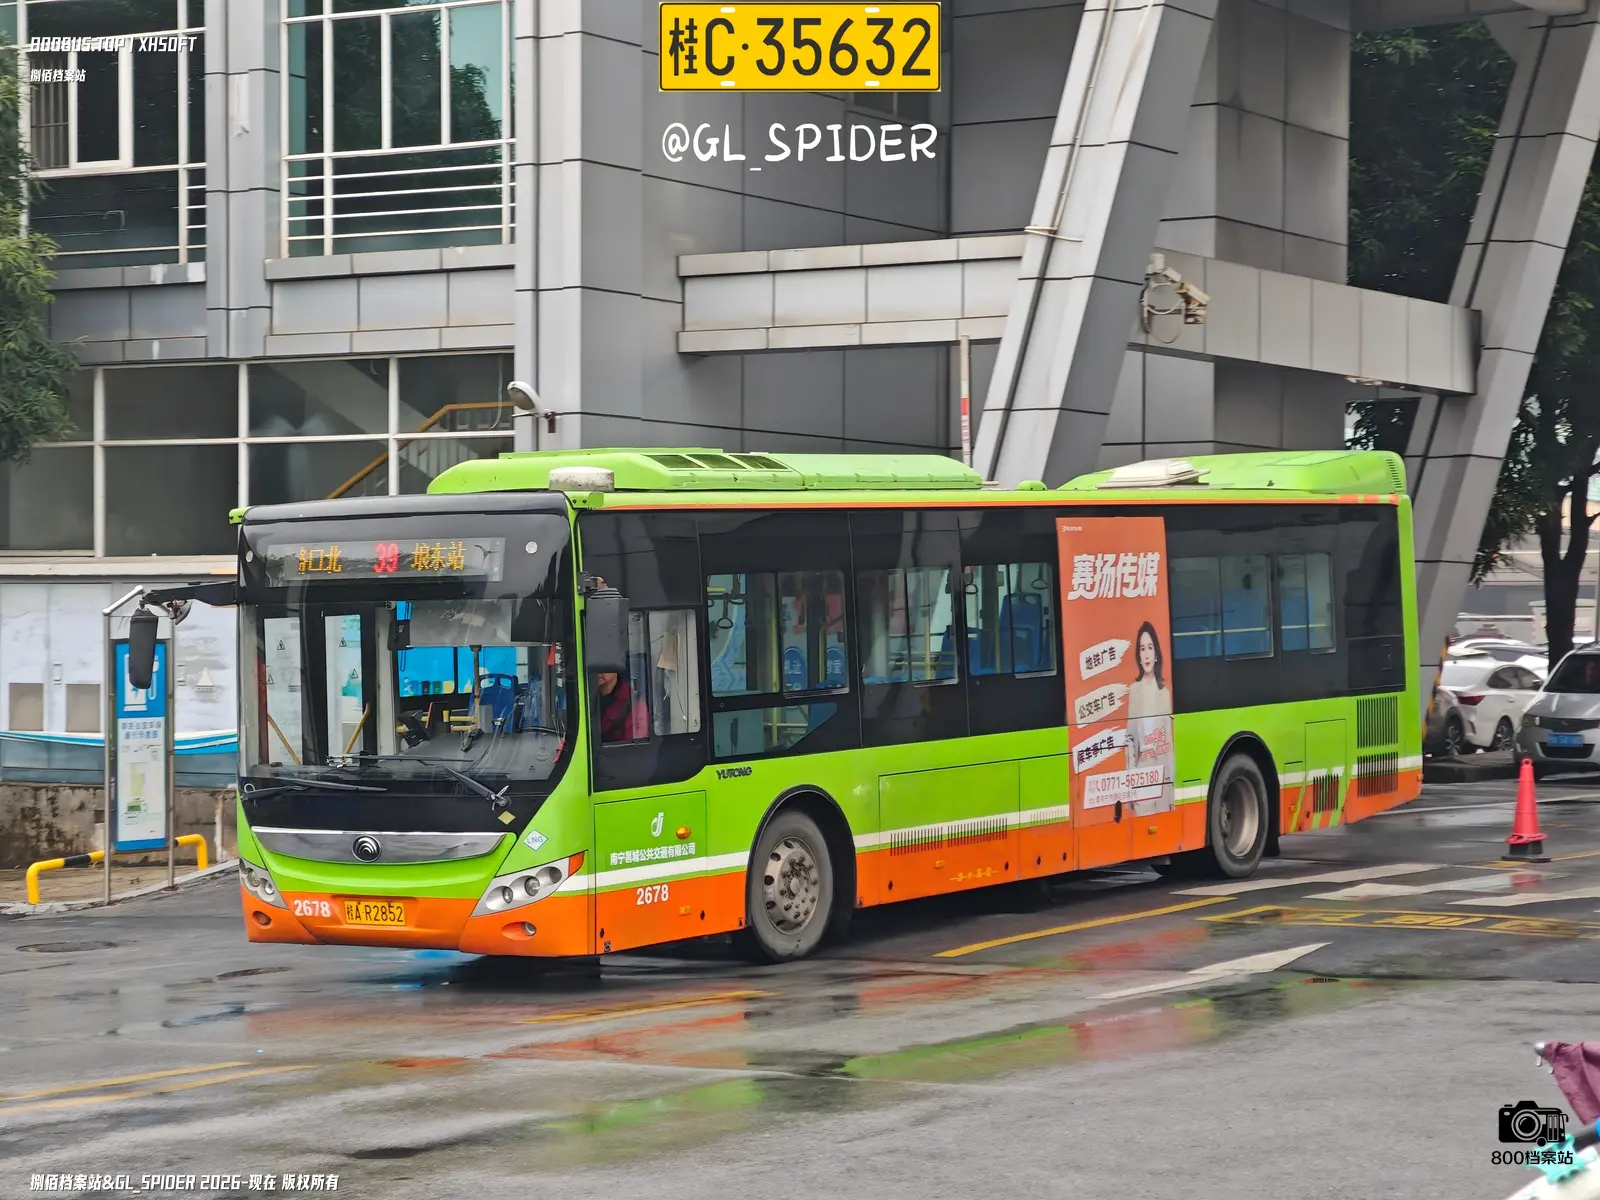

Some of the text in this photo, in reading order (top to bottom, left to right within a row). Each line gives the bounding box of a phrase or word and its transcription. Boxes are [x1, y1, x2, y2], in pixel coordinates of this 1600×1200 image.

[372, 541, 400, 575] 39
[1067, 552, 1161, 600] 赛扬传媒
[1085, 645, 1117, 671] 地铁广告
[1078, 691, 1117, 720] 公交车广告
[715, 766, 753, 780] YUTONG
[1101, 770, 1160, 792] 0771-5675180
[526, 835, 545, 844] LNG
[636, 884, 669, 905] 2678
[293, 899, 331, 918] 2678
